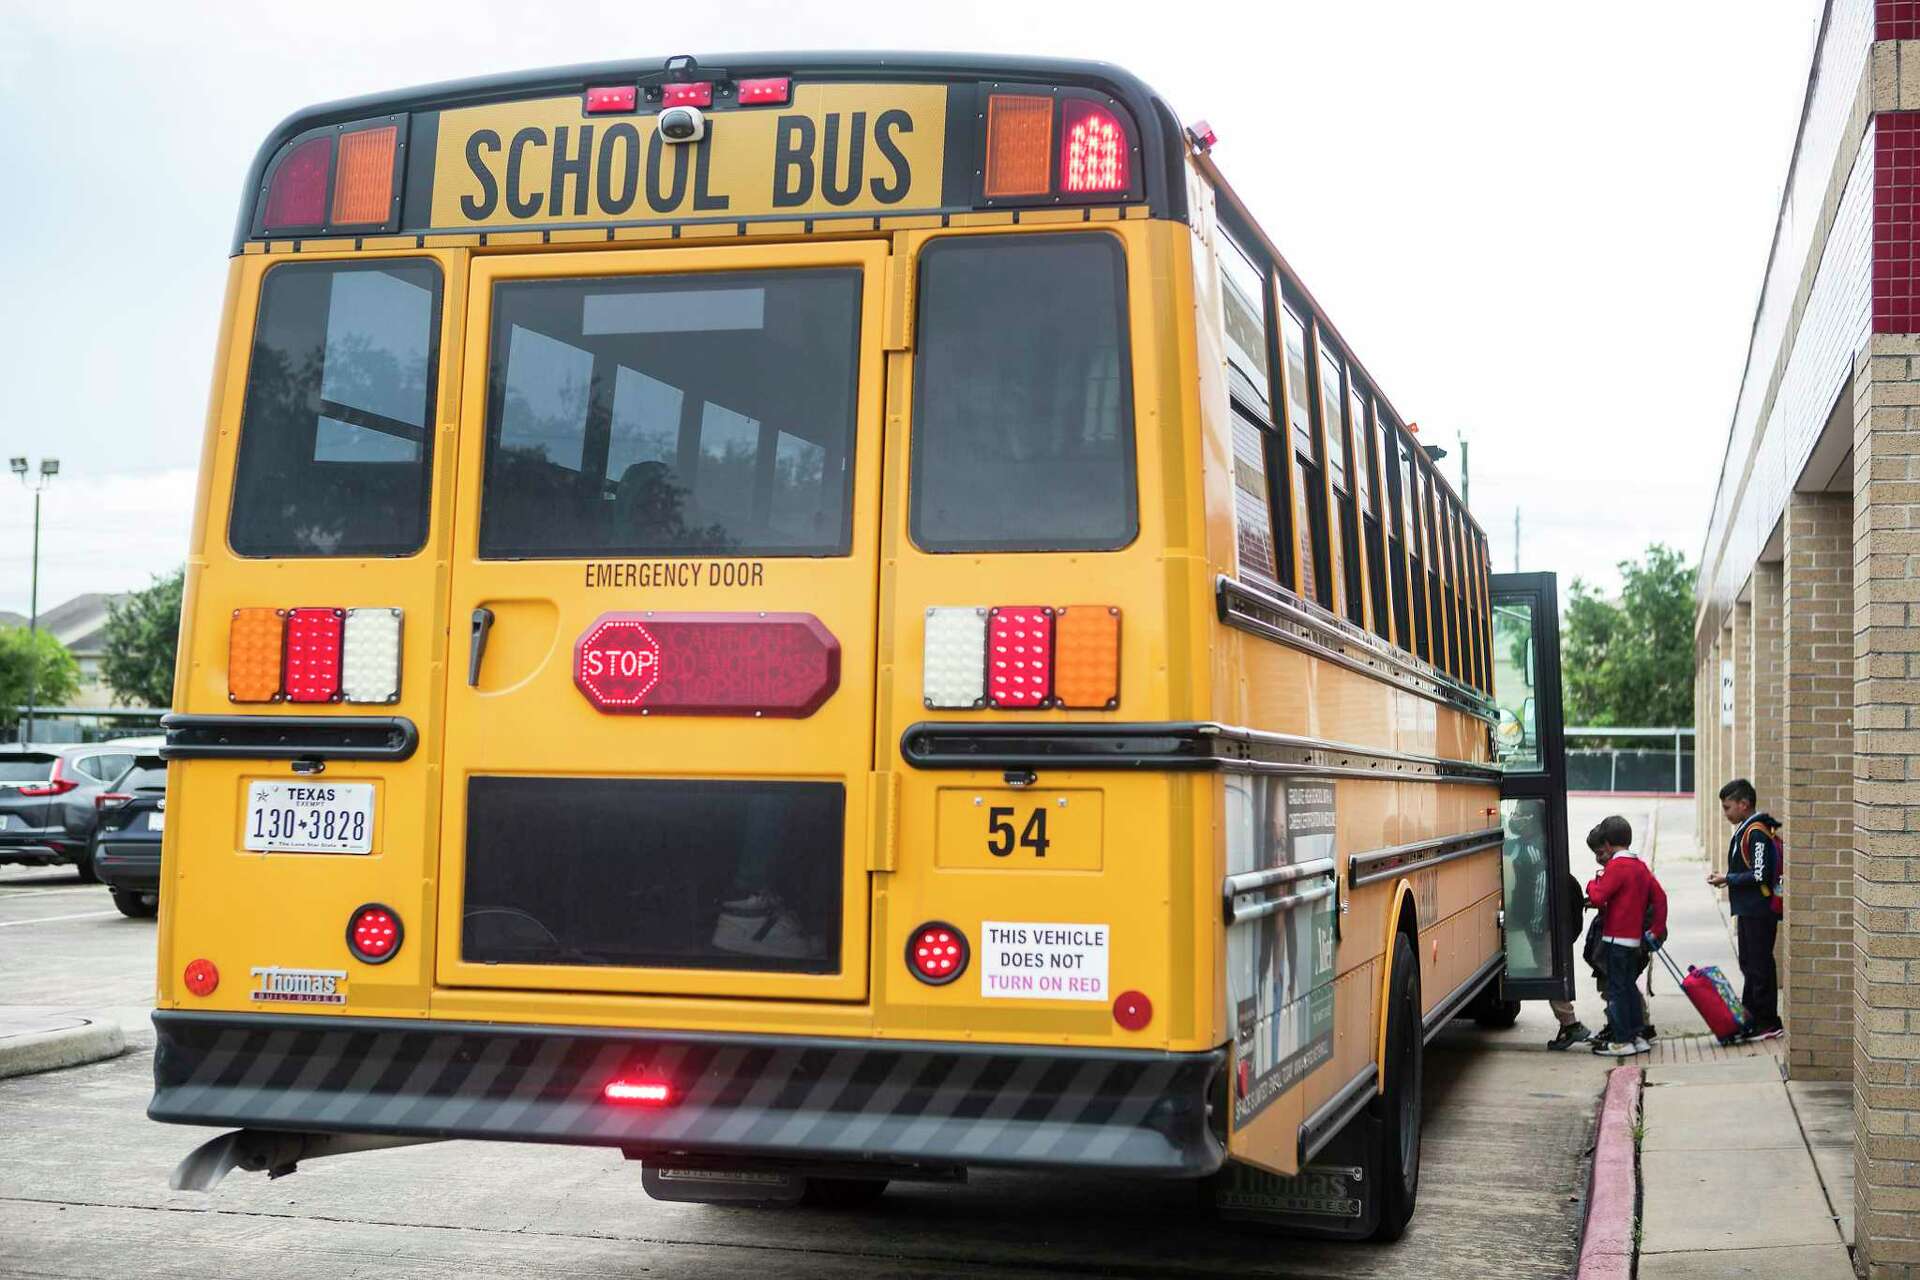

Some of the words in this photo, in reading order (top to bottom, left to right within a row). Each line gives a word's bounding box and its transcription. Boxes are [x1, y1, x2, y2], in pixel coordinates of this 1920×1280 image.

[460, 117, 730, 220] SCHOOL
[772, 109, 914, 209] BUS
[585, 562, 703, 587] EMERGENCY
[709, 562, 763, 587] DOOR
[587, 650, 654, 677] STOP
[287, 788, 336, 802] TEXAS
[987, 806, 1050, 857] 54
[989, 929, 1027, 945] THIS
[1033, 930, 1104, 947] VEHICLE
[1000, 952, 1044, 969] DOES
[1050, 954, 1084, 969] NOT
[252, 966, 349, 994] Thomas
[988, 975, 1034, 991] TURN
[1039, 976, 1063, 992] ON
[1069, 977, 1101, 993] RED
